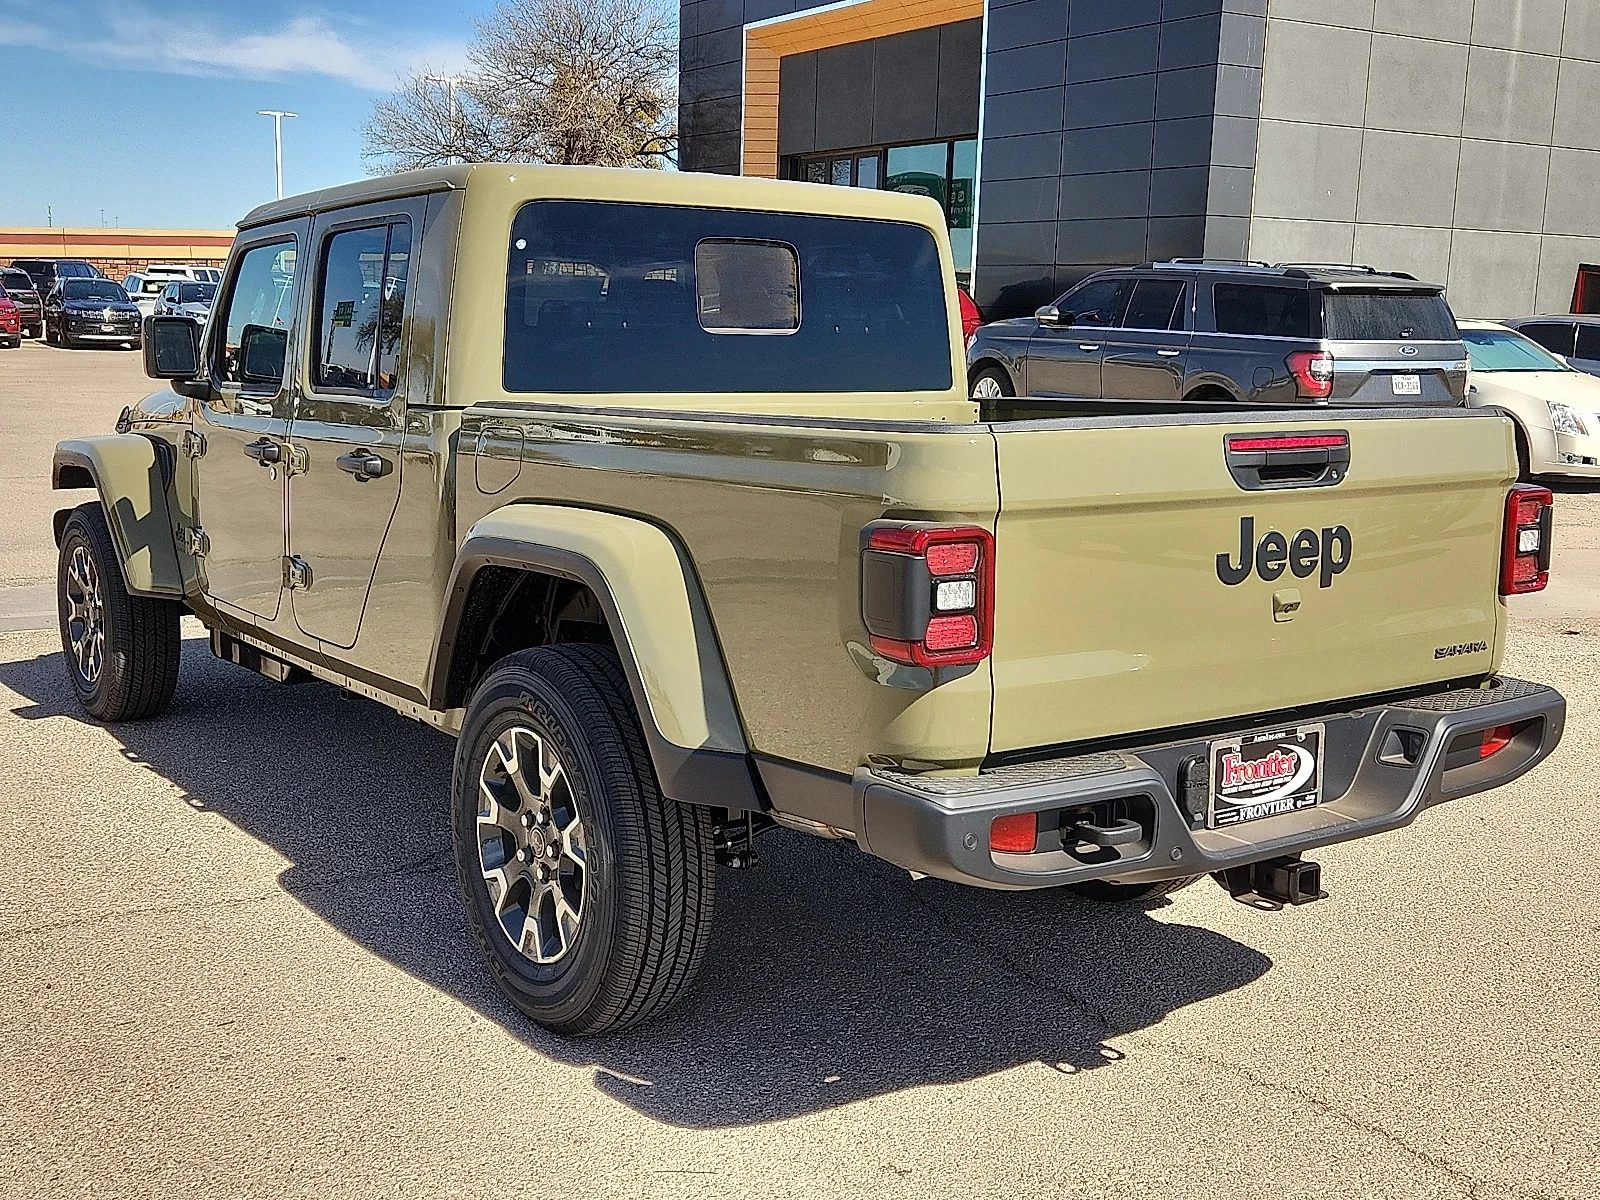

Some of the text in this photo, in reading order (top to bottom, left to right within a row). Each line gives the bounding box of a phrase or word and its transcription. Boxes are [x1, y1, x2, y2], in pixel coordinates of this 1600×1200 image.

[1216, 516, 1352, 588] Jeep
[1434, 640, 1488, 660] SAHARA
[1222, 750, 1297, 786] Frontier
[1239, 798, 1294, 822] FRONTIER
